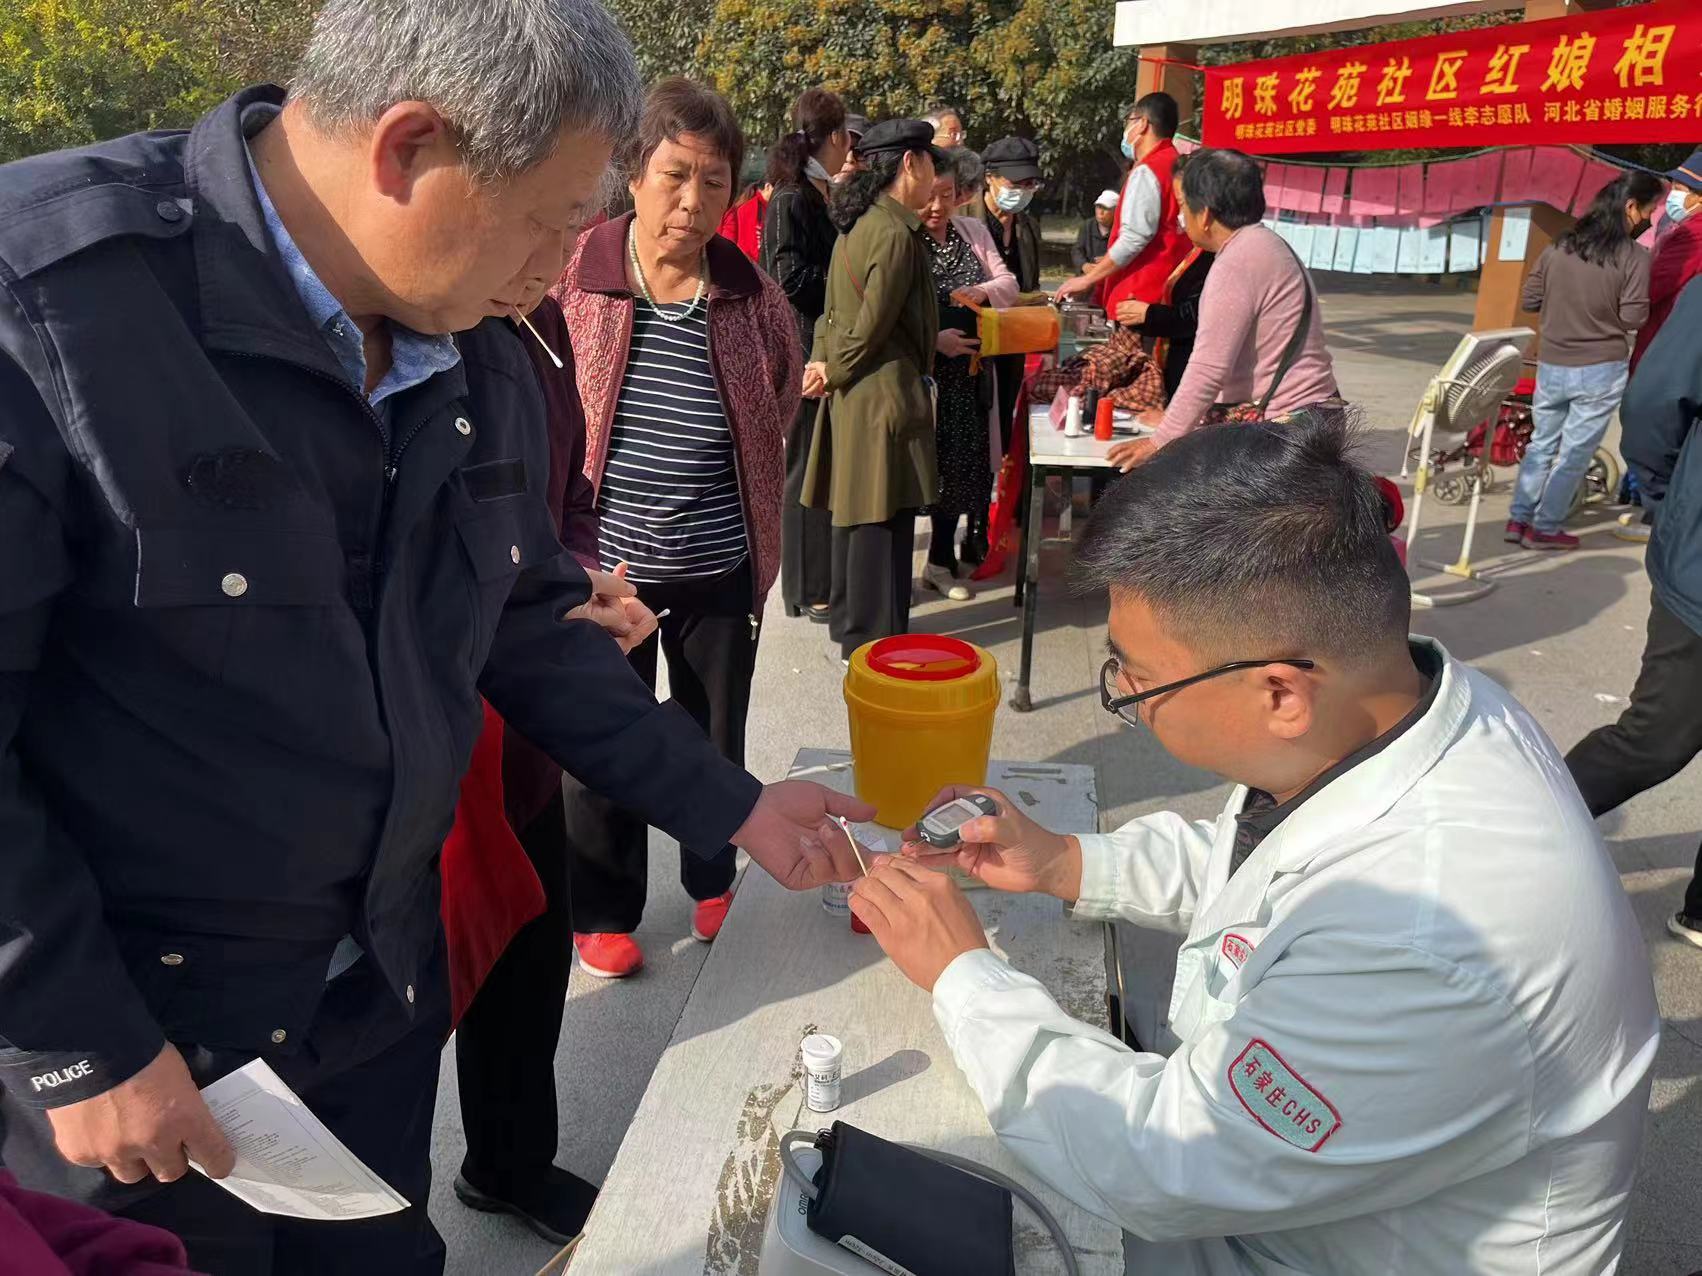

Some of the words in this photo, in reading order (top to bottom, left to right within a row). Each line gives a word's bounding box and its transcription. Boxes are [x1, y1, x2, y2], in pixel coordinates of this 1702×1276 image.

[1220, 24, 1702, 120] 明珠花苑社区红娘相
[30, 1059, 94, 1092] POLICE
[1244, 1056, 1321, 1134] 石家庄CHS
[797, 1189, 809, 1216] OMR
